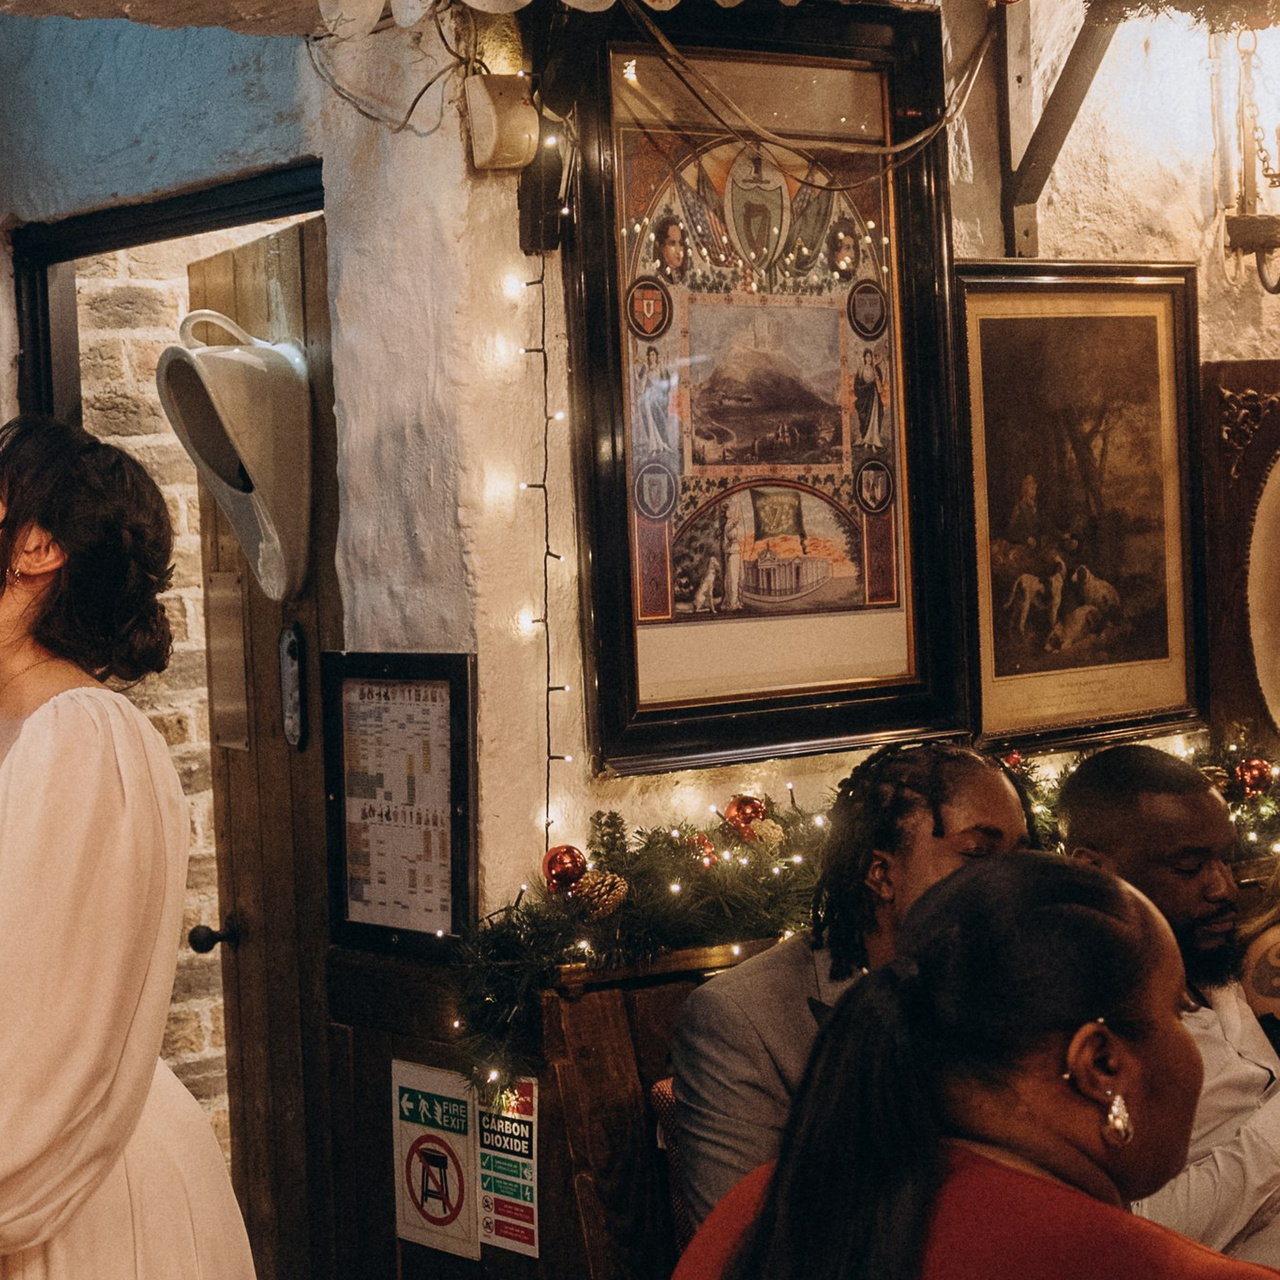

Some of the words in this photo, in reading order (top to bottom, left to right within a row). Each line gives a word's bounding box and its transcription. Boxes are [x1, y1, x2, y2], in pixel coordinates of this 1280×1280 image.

[442, 1101, 466, 1118] FIRE
[442, 1116, 466, 1131] EXIT
[482, 1115, 529, 1138] CARBON
[483, 1133, 529, 1154] DIOXIDE
